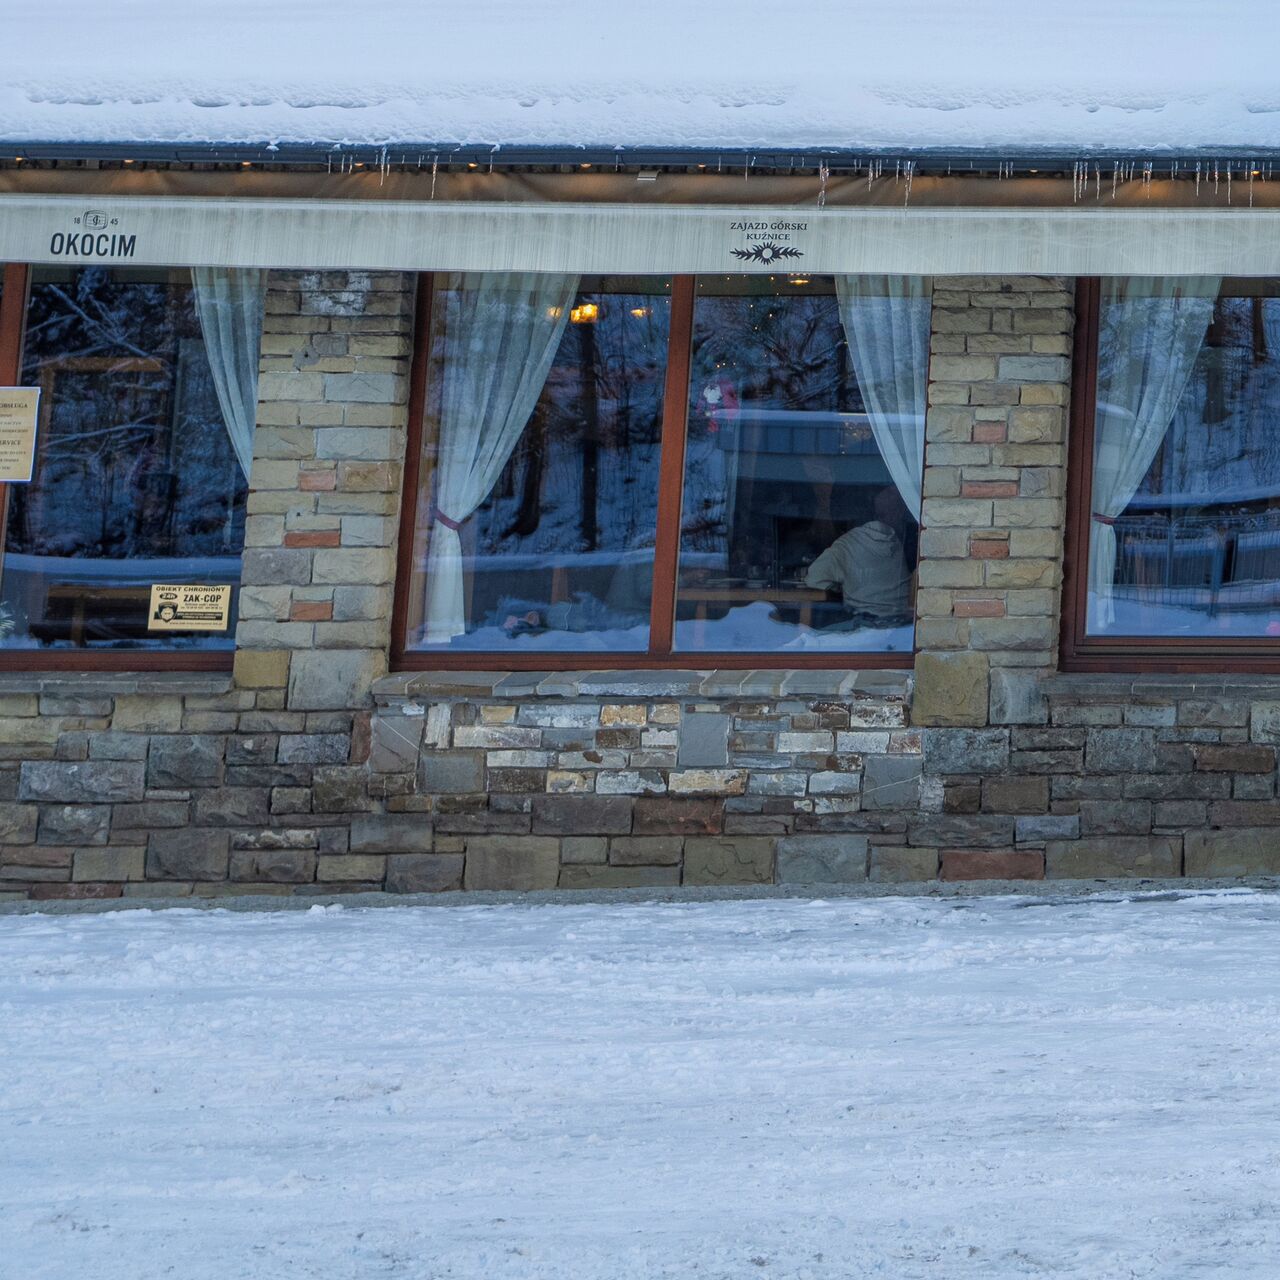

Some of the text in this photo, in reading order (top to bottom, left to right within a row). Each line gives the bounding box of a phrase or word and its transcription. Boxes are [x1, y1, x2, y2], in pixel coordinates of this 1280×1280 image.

[110, 218, 119, 226] 45
[730, 221, 808, 231] ZAJAZD GÓRSKI
[746, 232, 791, 240] KUŹNICE
[50, 232, 137, 257] OKOCIM
[183, 594, 222, 602] ZAK-COP
